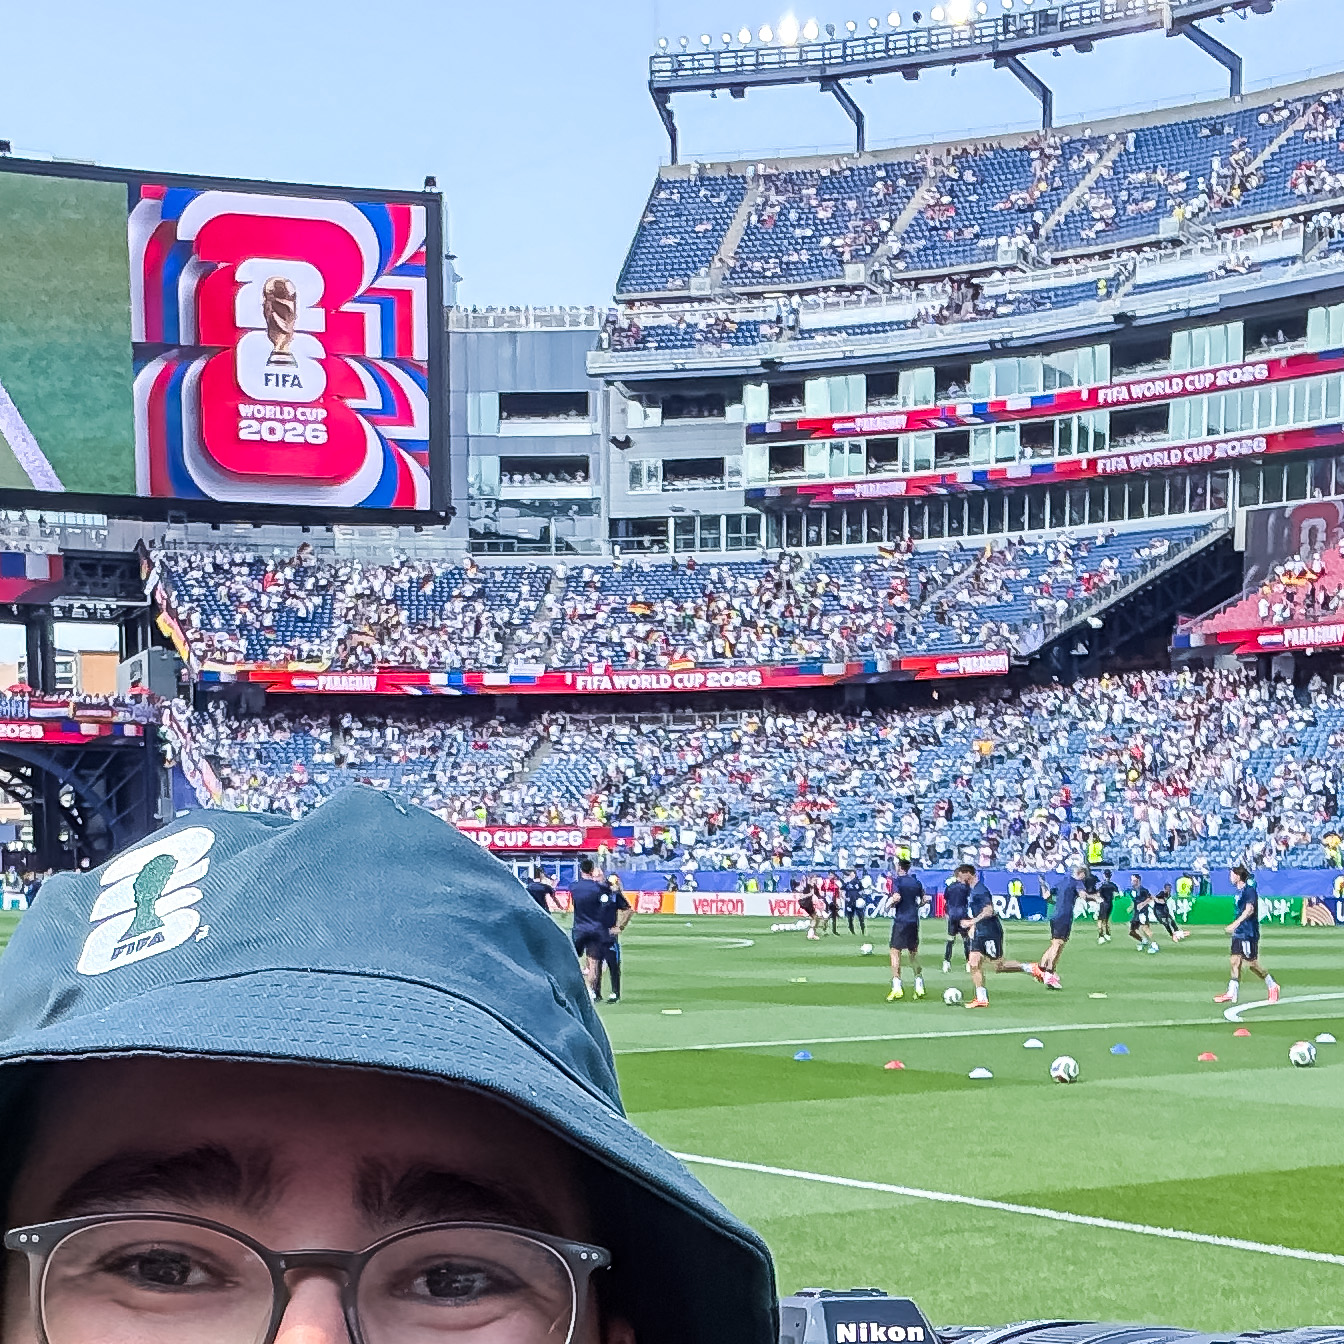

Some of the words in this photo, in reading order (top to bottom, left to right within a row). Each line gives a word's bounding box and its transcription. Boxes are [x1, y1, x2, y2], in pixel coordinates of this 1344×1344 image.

[264, 373, 303, 388] FIFA
[1099, 386, 1128, 406] FIFA
[1131, 378, 1183, 399] WORLD
[1185, 373, 1215, 393] CUP
[238, 404, 294, 420] WORLD
[296, 407, 327, 421] CUP
[238, 420, 328, 444] 2026
[577, 675, 606, 691] FIFA
[607, 674, 672, 690] WORLD
[673, 673, 705, 689] CUP
[706, 670, 762, 687] 2026
[494, 831, 528, 846] CUP
[530, 831, 582, 846] 2026
[693, 894, 744, 915] verizon
[110, 931, 165, 962] FIFA
[836, 1322, 925, 1344] Nikon
